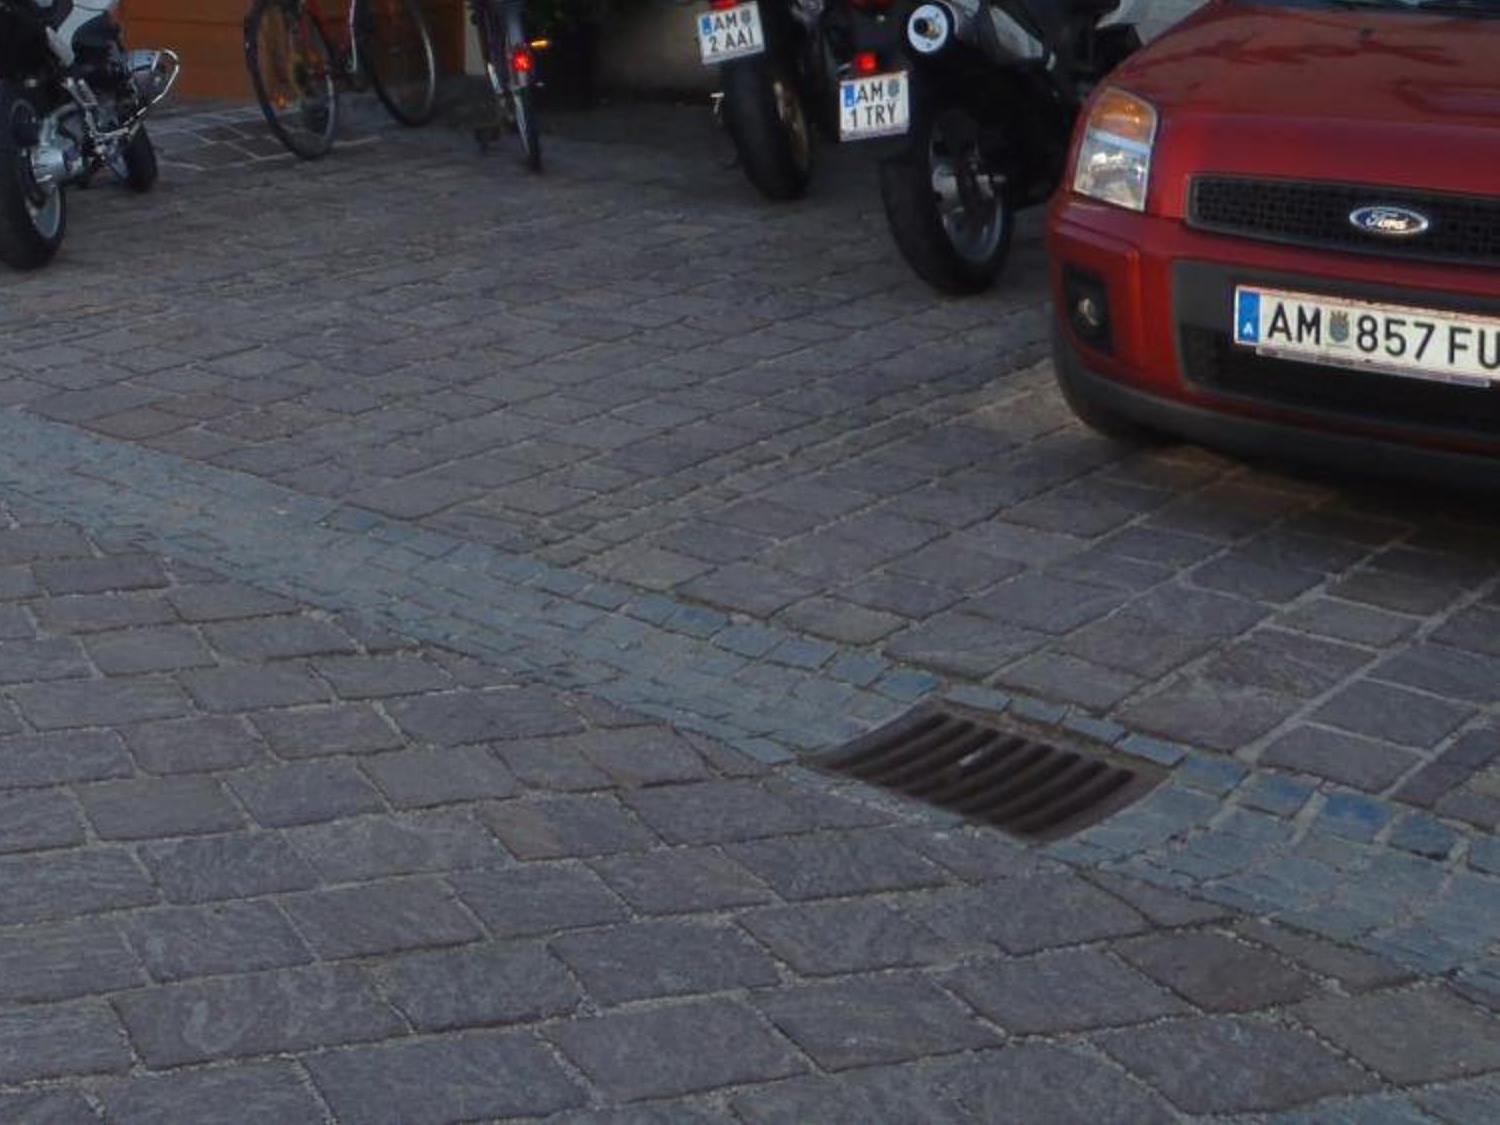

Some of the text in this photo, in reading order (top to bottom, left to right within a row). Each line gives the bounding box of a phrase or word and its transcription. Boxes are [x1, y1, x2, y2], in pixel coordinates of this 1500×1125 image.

[713, 12, 738, 30] AM
[710, 36, 719, 53] 2
[857, 82, 883, 102] AM
[850, 102, 897, 127] 1 TRY
[1267, 301, 1322, 346] AM
[1356, 314, 1436, 361] 857
